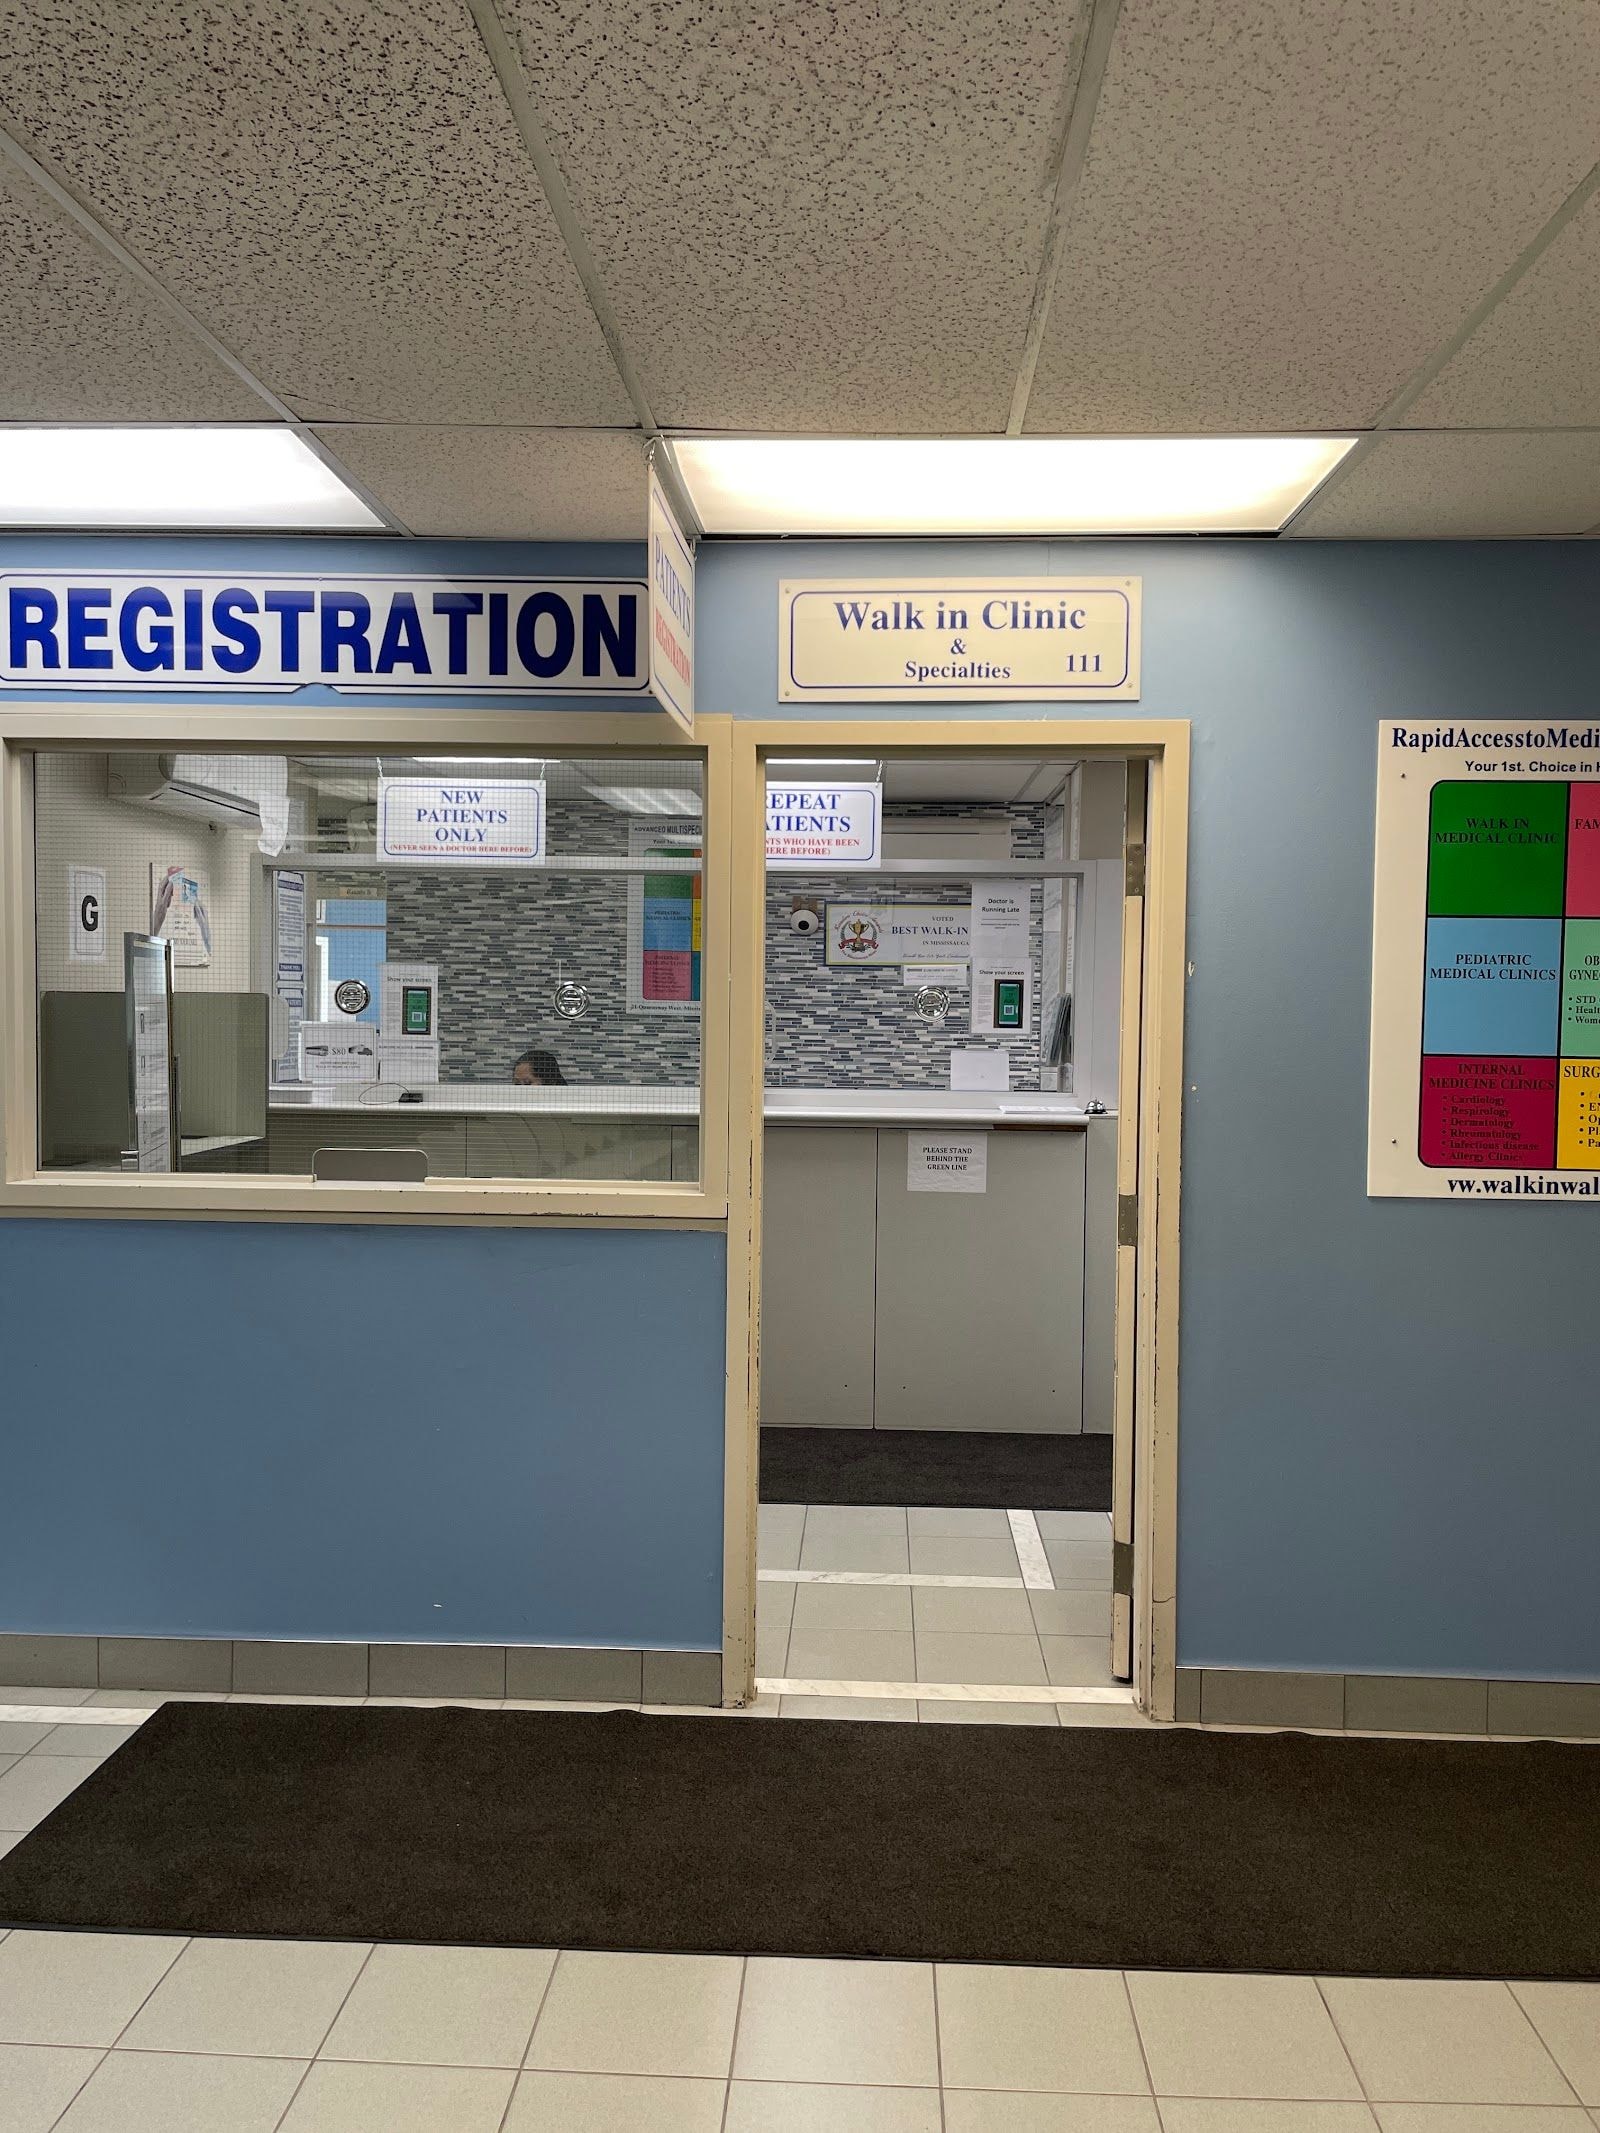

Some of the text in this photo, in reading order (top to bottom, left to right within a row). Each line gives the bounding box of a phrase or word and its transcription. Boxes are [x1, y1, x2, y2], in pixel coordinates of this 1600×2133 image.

[655, 535, 691, 638] PATIENTS
[834, 600, 1086, 631] Walk in Clinic
[8, 587, 637, 678] REGISTRATION
[655, 607, 691, 688] REGISTRATION
[951, 638, 967, 655] &
[1066, 655, 1102, 673] 111
[905, 661, 1011, 682] Specialties
[1465, 761, 1498, 772] Your
[1502, 761, 1525, 772] 1st.
[1529, 761, 1576, 772] Choice
[1580, 762, 1592, 772] in
[442, 791, 484, 804] NEW
[766, 793, 841, 810] EPEAT
[417, 809, 508, 824] PATIENTS
[1466, 818, 1529, 829] WALK IN
[435, 828, 487, 842] ONLY
[1435, 832, 1560, 844] MEDICAL CLINIC
[783, 838, 806, 846] WHO
[81, 895, 99, 932] G
[892, 926, 968, 935] BEST WALK-IN
[1456, 954, 1532, 965] PEDIATRIC
[1430, 968, 1556, 980] MEDICAL CLINICS
[1569, 969, 1600, 980] GYNE
[1576, 995, 1596, 1004] STD
[1459, 1064, 1525, 1075] INTERNAL
[1563, 1066, 1600, 1078] SURG
[1429, 1077, 1555, 1090] MEDICINE CLINICS
[1451, 1095, 1506, 1106] Cardiology
[1451, 1107, 1510, 1117] Respirology
[1450, 1118, 1515, 1129] Dermatology
[1450, 1129, 1522, 1140] Rheumatology
[1450, 1139, 1539, 1150] Infectious disease
[1449, 1152, 1484, 1162] Allergy
